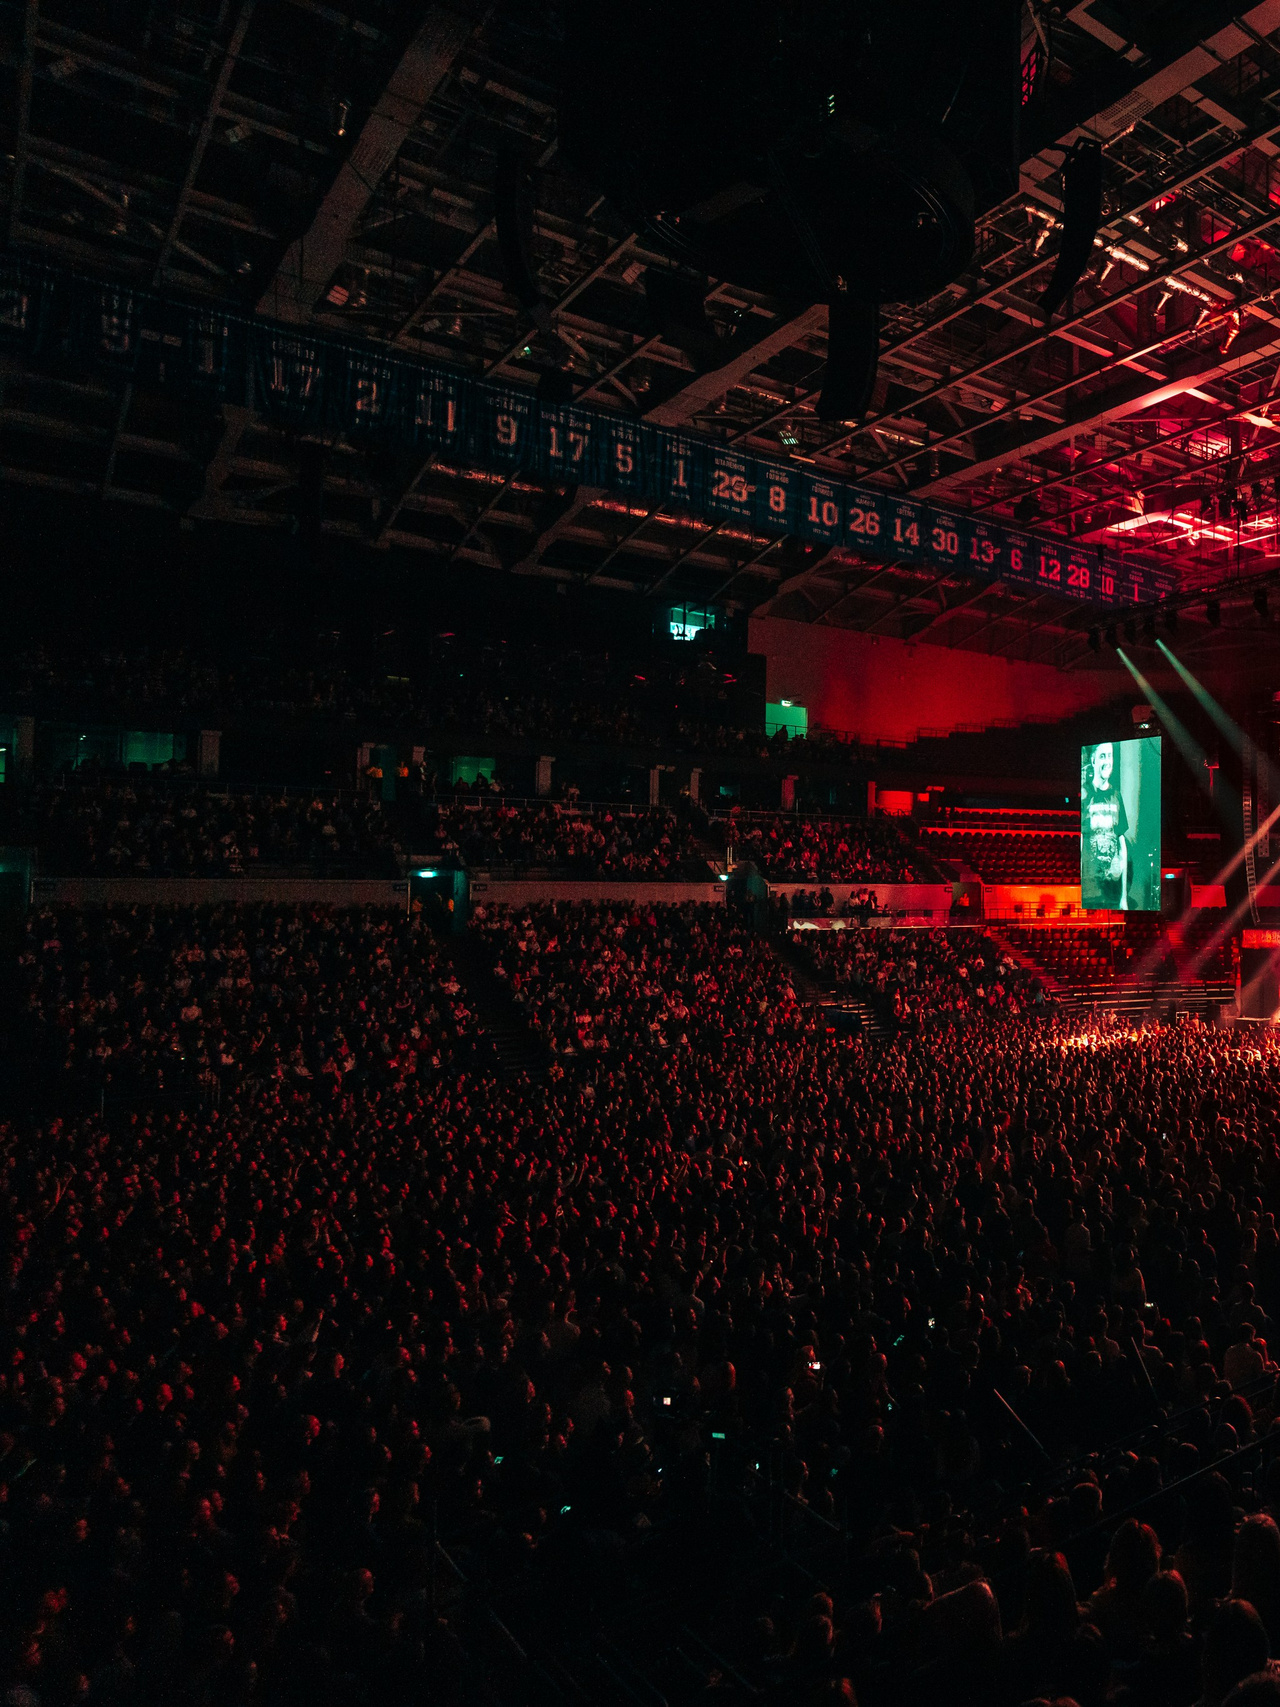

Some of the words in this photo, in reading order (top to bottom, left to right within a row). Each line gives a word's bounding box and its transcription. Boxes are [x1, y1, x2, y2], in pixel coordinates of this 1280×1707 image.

[496, 413, 519, 447] 9
[549, 425, 589, 462] 17
[615, 443, 635, 473] 5
[672, 459, 688, 489] 1
[768, 485, 787, 513] 8
[808, 496, 838, 527] 10
[849, 507, 880, 537] 26
[893, 517, 920, 547] 14
[931, 526, 960, 556] 30
[969, 537, 995, 564] 13
[1010, 549, 1024, 572] 6
[1038, 555, 1061, 583] 12
